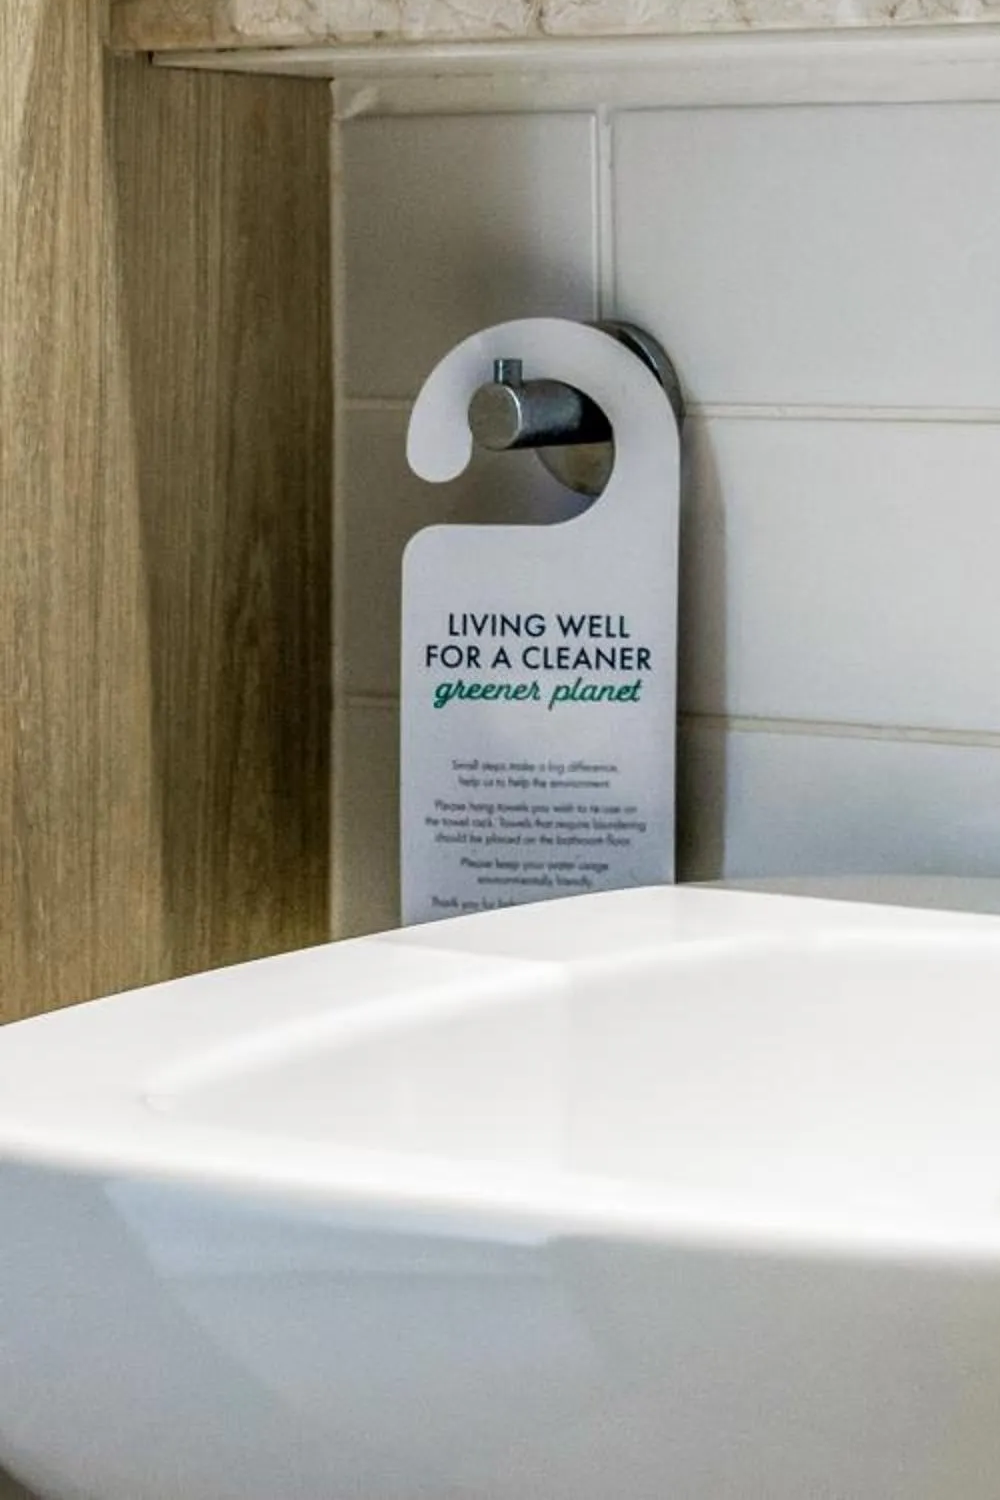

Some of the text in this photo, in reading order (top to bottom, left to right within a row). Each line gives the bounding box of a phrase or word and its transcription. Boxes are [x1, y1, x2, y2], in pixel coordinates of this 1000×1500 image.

[448, 613, 630, 638] LIVING WELL
[425, 645, 652, 671] FOR A CLEANER
[433, 677, 643, 711] greener planet
[434, 799, 466, 811] Please
[469, 801, 494, 814] hang
[496, 802, 529, 813] towels
[530, 804, 550, 814] you
[425, 815, 440, 826] the
[442, 816, 469, 827] towel
[499, 817, 531, 828] Towels
[592, 819, 646, 832] laundering
[434, 831, 467, 843] should
[485, 832, 521, 845] placed
[556, 834, 604, 846] bathroom
[460, 856, 492, 869] Please
[494, 858, 520, 870] keep
